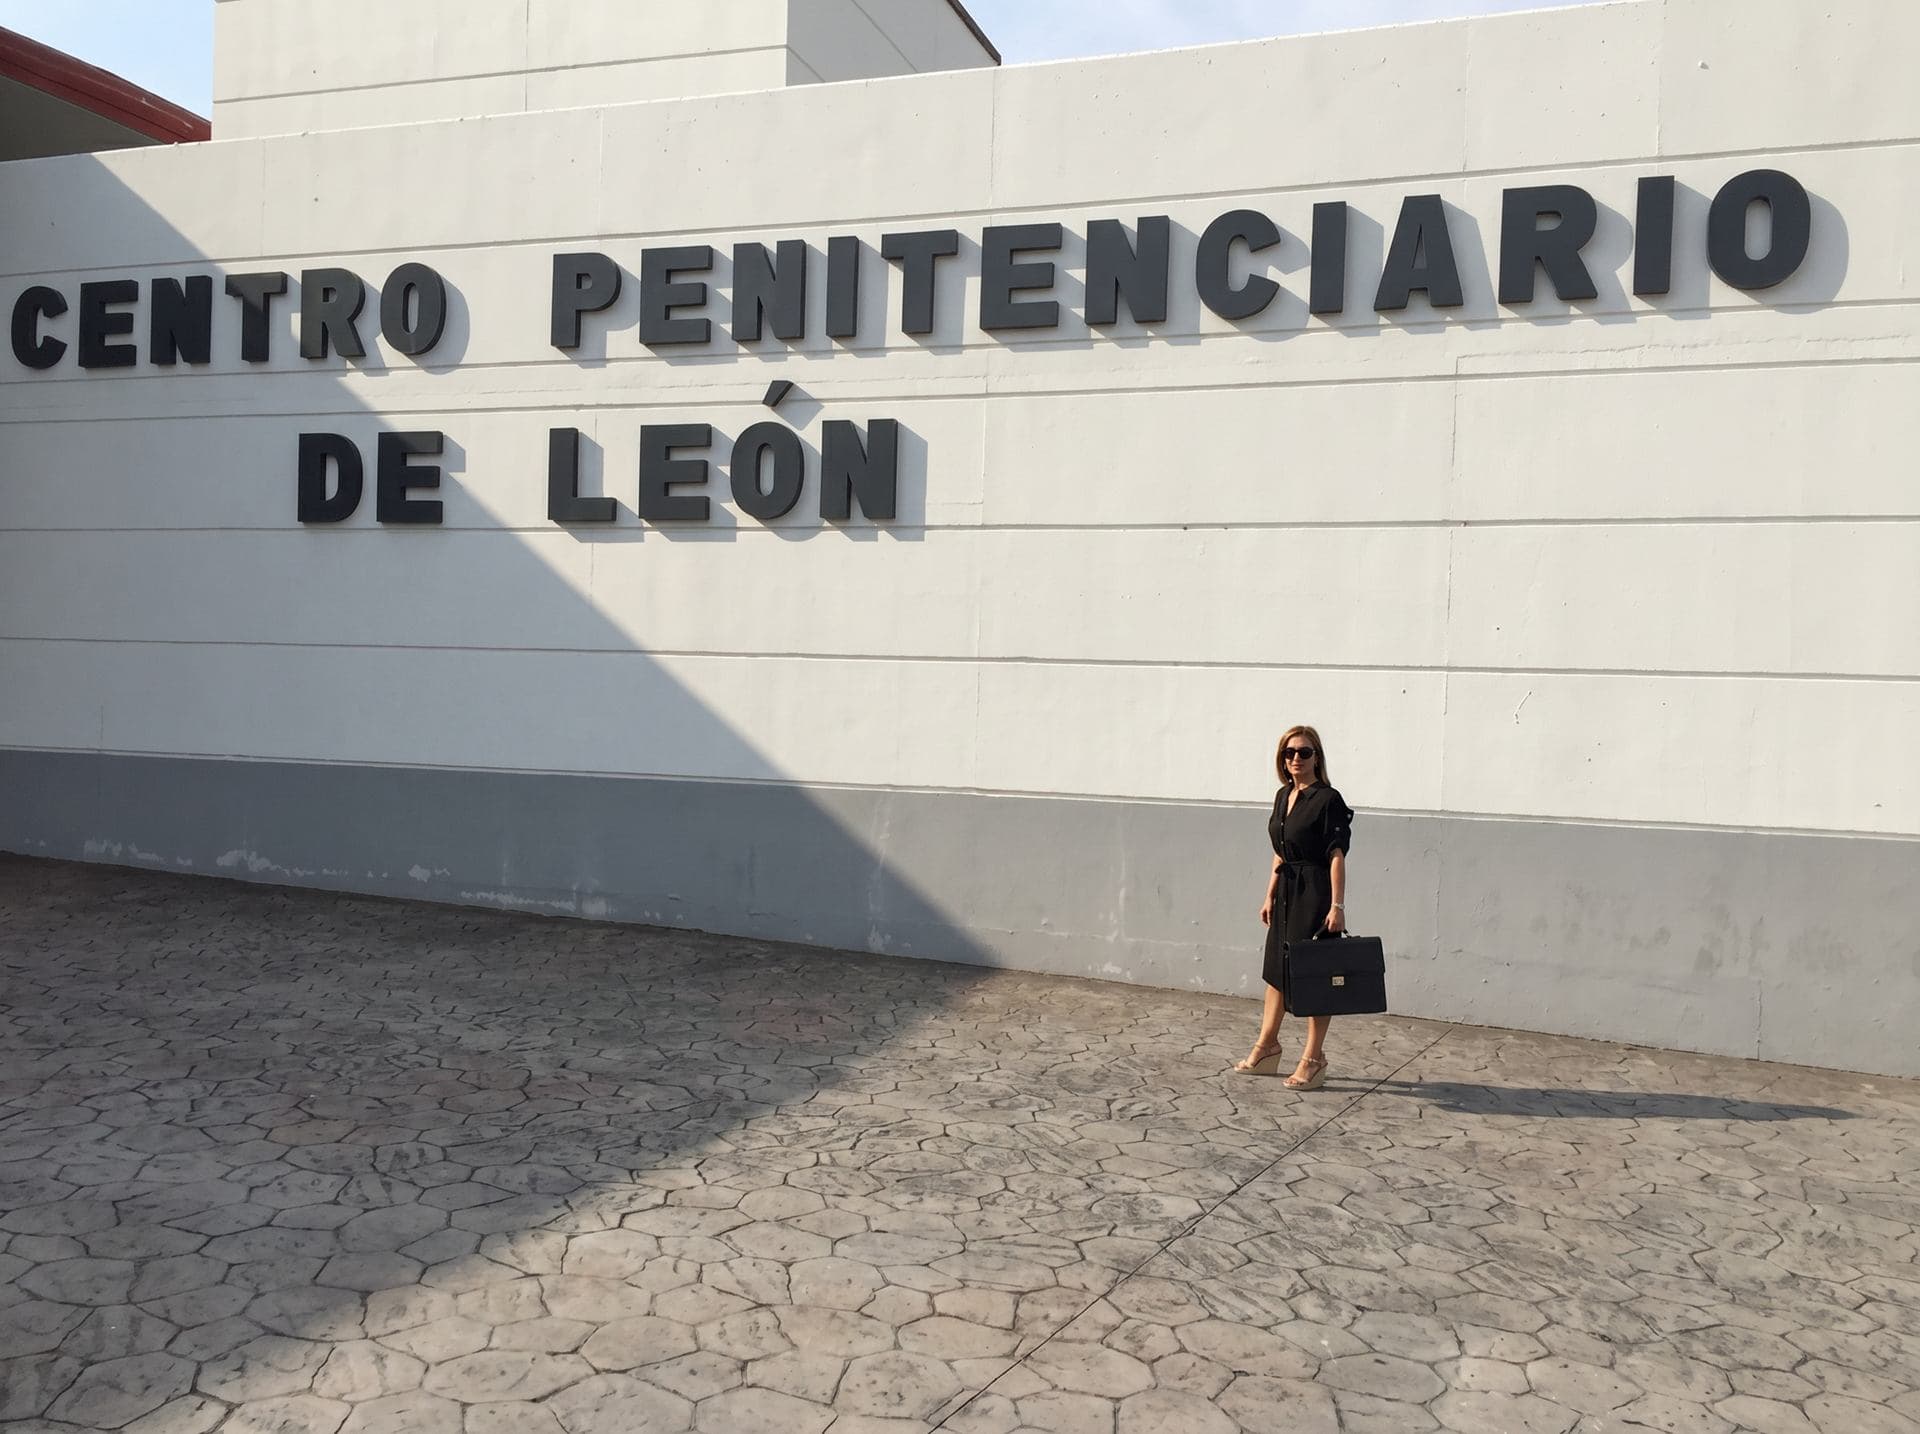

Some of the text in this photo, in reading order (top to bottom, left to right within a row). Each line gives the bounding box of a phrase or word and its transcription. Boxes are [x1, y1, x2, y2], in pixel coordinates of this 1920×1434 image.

[11, 169, 1811, 371] CENTRO PENITENCIARIO
[297, 380, 899, 525] DE LEÓN
